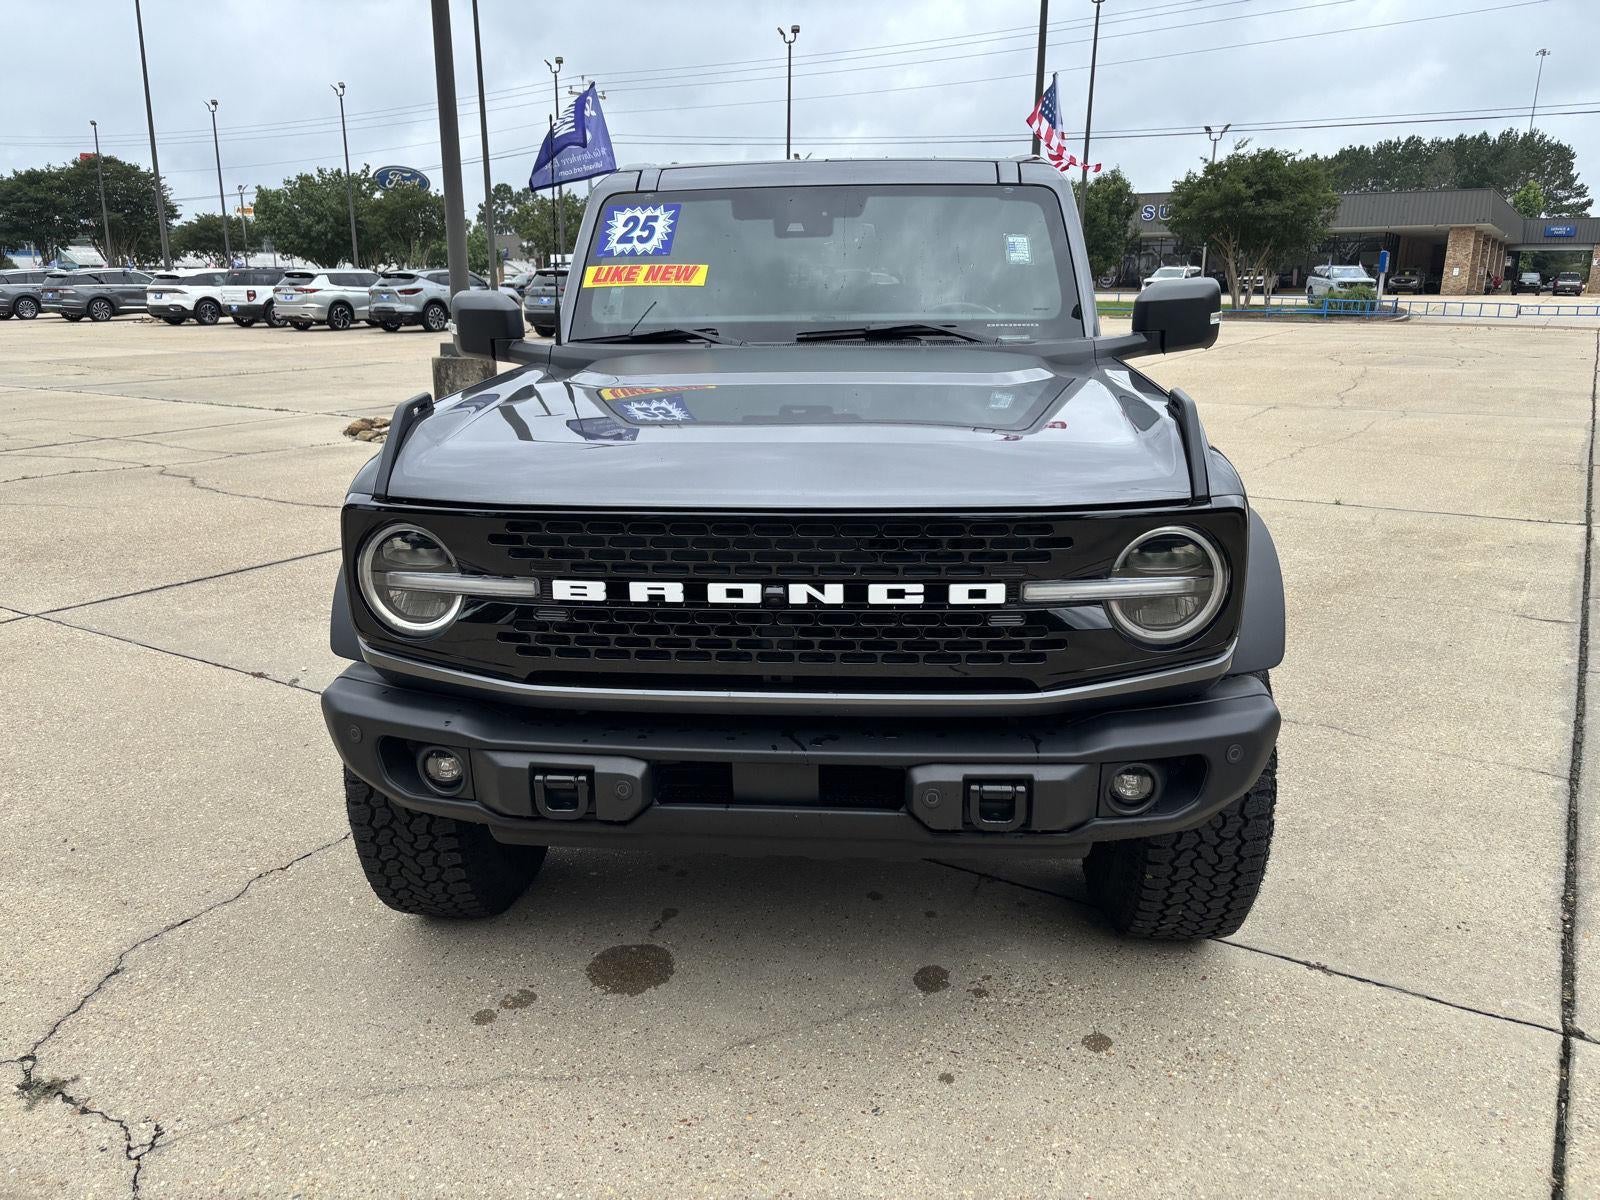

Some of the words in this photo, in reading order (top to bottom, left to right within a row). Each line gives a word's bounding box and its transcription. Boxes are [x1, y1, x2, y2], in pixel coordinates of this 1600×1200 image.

[616, 214, 660, 245] 25
[592, 266, 643, 284] LIKE
[643, 265, 700, 284] NEW
[552, 579, 1006, 605] BRONCO
